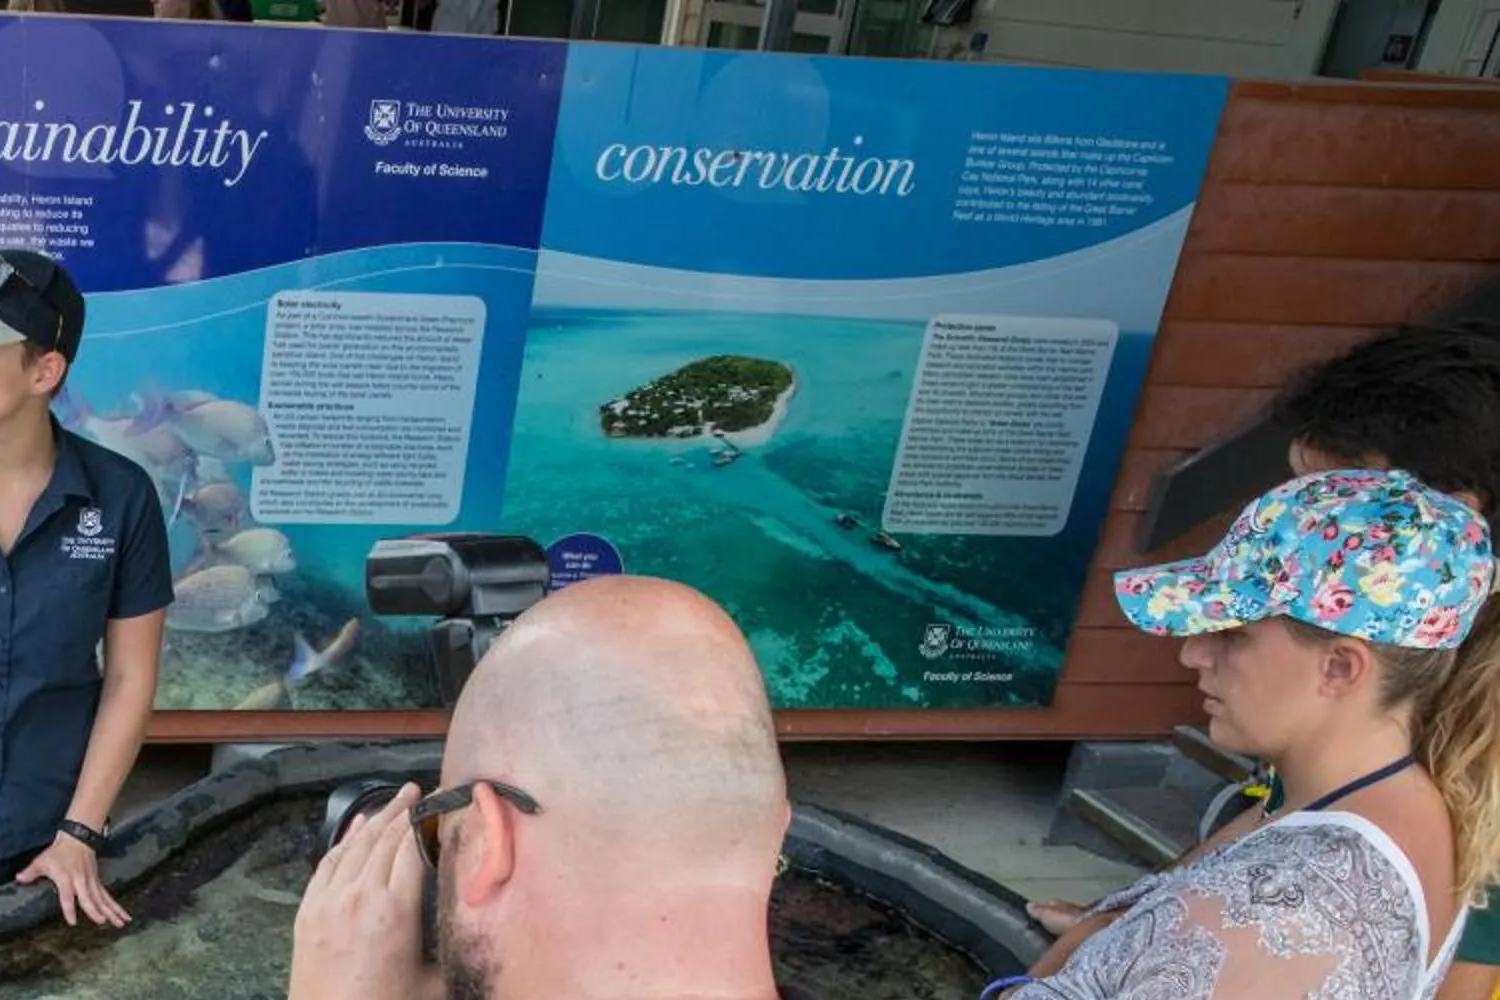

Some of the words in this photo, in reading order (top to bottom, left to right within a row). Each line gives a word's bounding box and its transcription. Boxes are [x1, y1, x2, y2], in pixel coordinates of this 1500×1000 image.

[406, 102, 433, 118] THE
[436, 103, 510, 121] UNIVERSITY
[425, 120, 508, 138] QUEENSLAND
[404, 139, 464, 149] AUSTRALIA
[375, 160, 421, 177] Faculty
[423, 162, 437, 176] of
[439, 162, 489, 178] Science
[595, 134, 916, 198] conservation
[63, 194, 93, 207] Island
[22, 208, 33, 219] to
[34, 208, 69, 220] reduce
[32, 222, 44, 233] to
[46, 222, 89, 236] reducing
[48, 237, 77, 248] waste
[79, 238, 95, 248] we
[923, 670, 960, 683] Faculty
[961, 671, 973, 682] of
[973, 671, 1014, 682] Science
